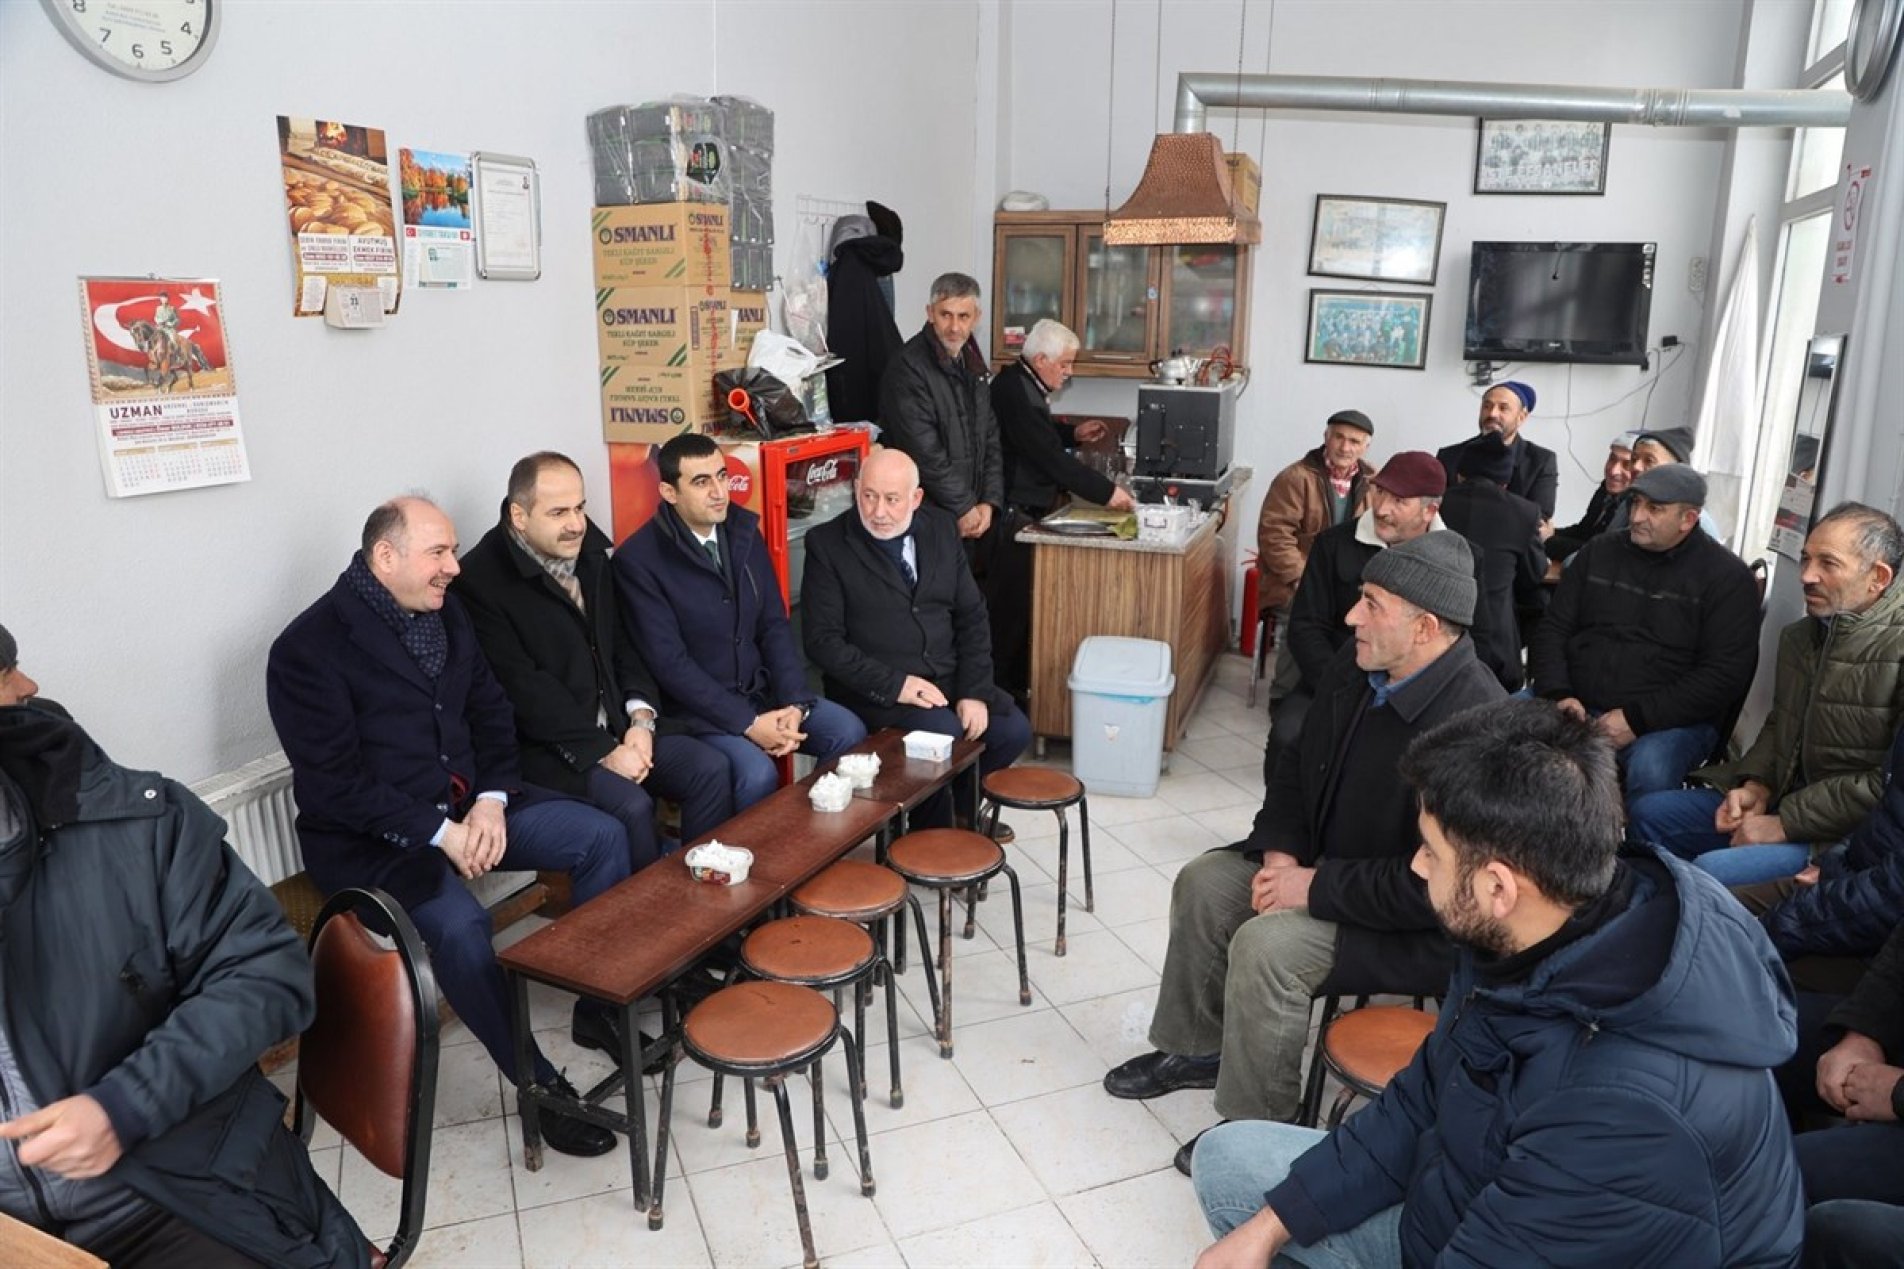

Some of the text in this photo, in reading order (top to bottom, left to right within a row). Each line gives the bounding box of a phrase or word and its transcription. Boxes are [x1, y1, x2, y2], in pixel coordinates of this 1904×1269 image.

[100, 27, 111, 42] 7
[180, 21, 192, 35] 4
[131, 43, 144, 59] 6
[160, 40, 173, 55] 5
[599, 224, 675, 245] OSMANLI
[603, 307, 677, 326] OSMANLI
[109, 404, 163, 419] UZMAN
[609, 407, 685, 425] OSMANLI
